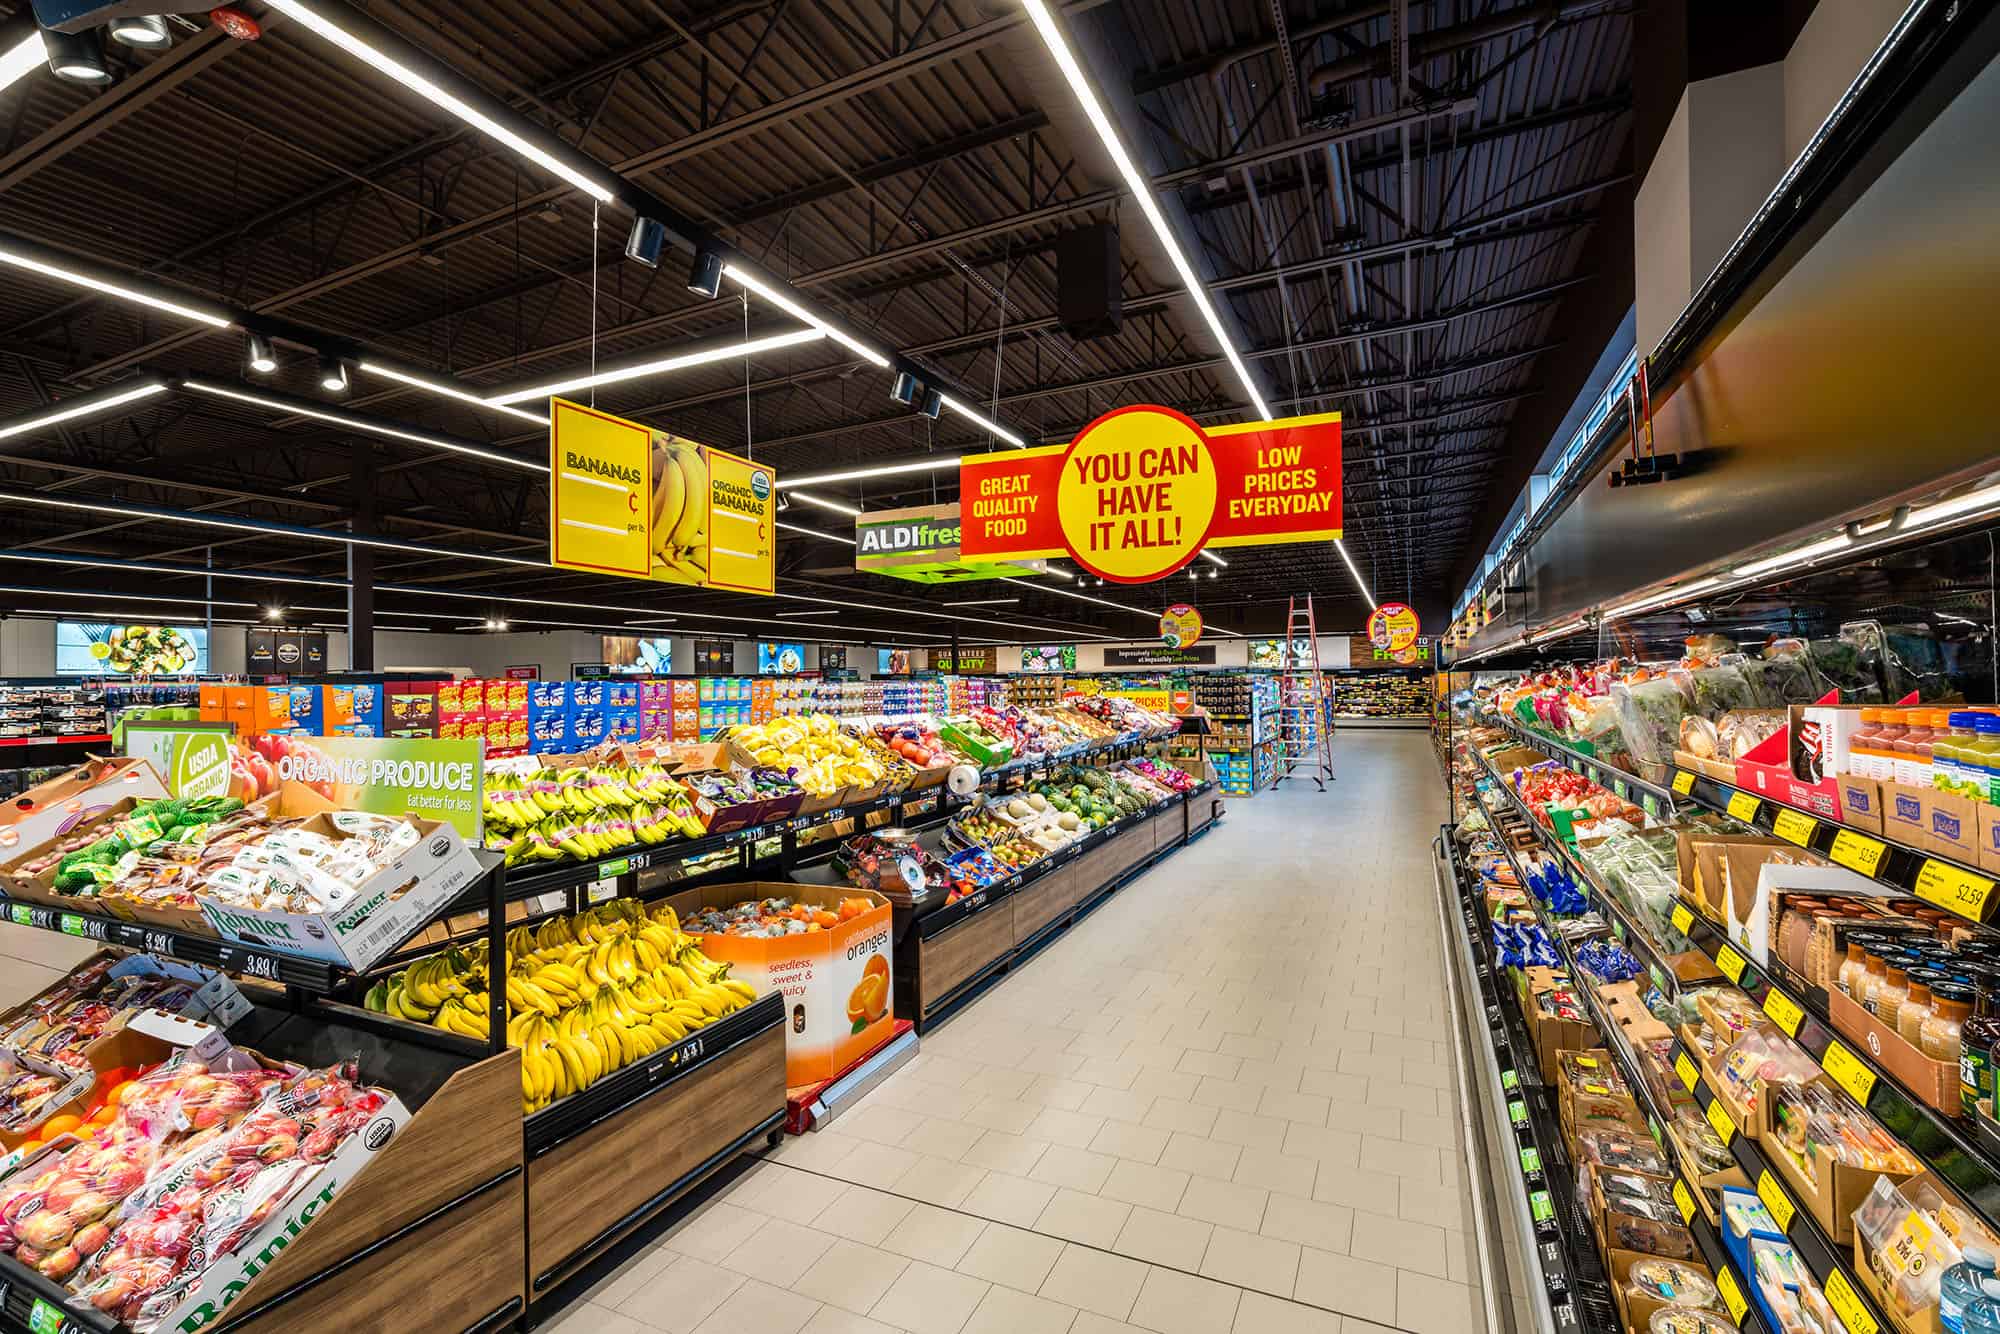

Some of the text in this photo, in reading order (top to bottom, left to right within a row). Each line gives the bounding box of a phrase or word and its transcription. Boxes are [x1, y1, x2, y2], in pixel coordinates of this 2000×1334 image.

[566, 451, 641, 485] BANANAS
[1074, 444, 1198, 485] YOU CAN
[1257, 445, 1302, 469] LOW
[712, 479, 751, 499] ORGANIC
[980, 474, 1031, 496] GREAT
[1244, 467, 1317, 494] PRICES
[712, 494, 764, 516] BANANAS
[973, 495, 1038, 518] QUALITY
[1097, 482, 1173, 517] HAVE
[1229, 490, 1334, 519] EVERYDAY
[627, 523, 638, 532] per
[861, 525, 960, 552] ALDIfres
[985, 518, 1027, 538] FOOD
[1090, 516, 1181, 552] IT ALL!
[1417, 637, 1428, 645] TO
[937, 659, 985, 670] QULITY
[938, 649, 985, 657] GUAANTEED
[1119, 649, 1150, 659] Impressively
[188, 743, 219, 776] USDA
[187, 767, 225, 800] ORGANIC
[278, 755, 474, 792] ORGANIC PRODUCE
[407, 793, 472, 811] Eat better for less
[1859, 847, 1878, 865] $2.59
[1956, 883, 1983, 906] $2.59
[200, 901, 298, 942] Rainier
[336, 890, 387, 936] Rainier
[847, 929, 888, 961] oranges
[768, 959, 813, 974] seedless,
[772, 970, 813, 985] sweet &
[781, 985, 806, 997] juicy
[369, 1122, 387, 1140] USDA
